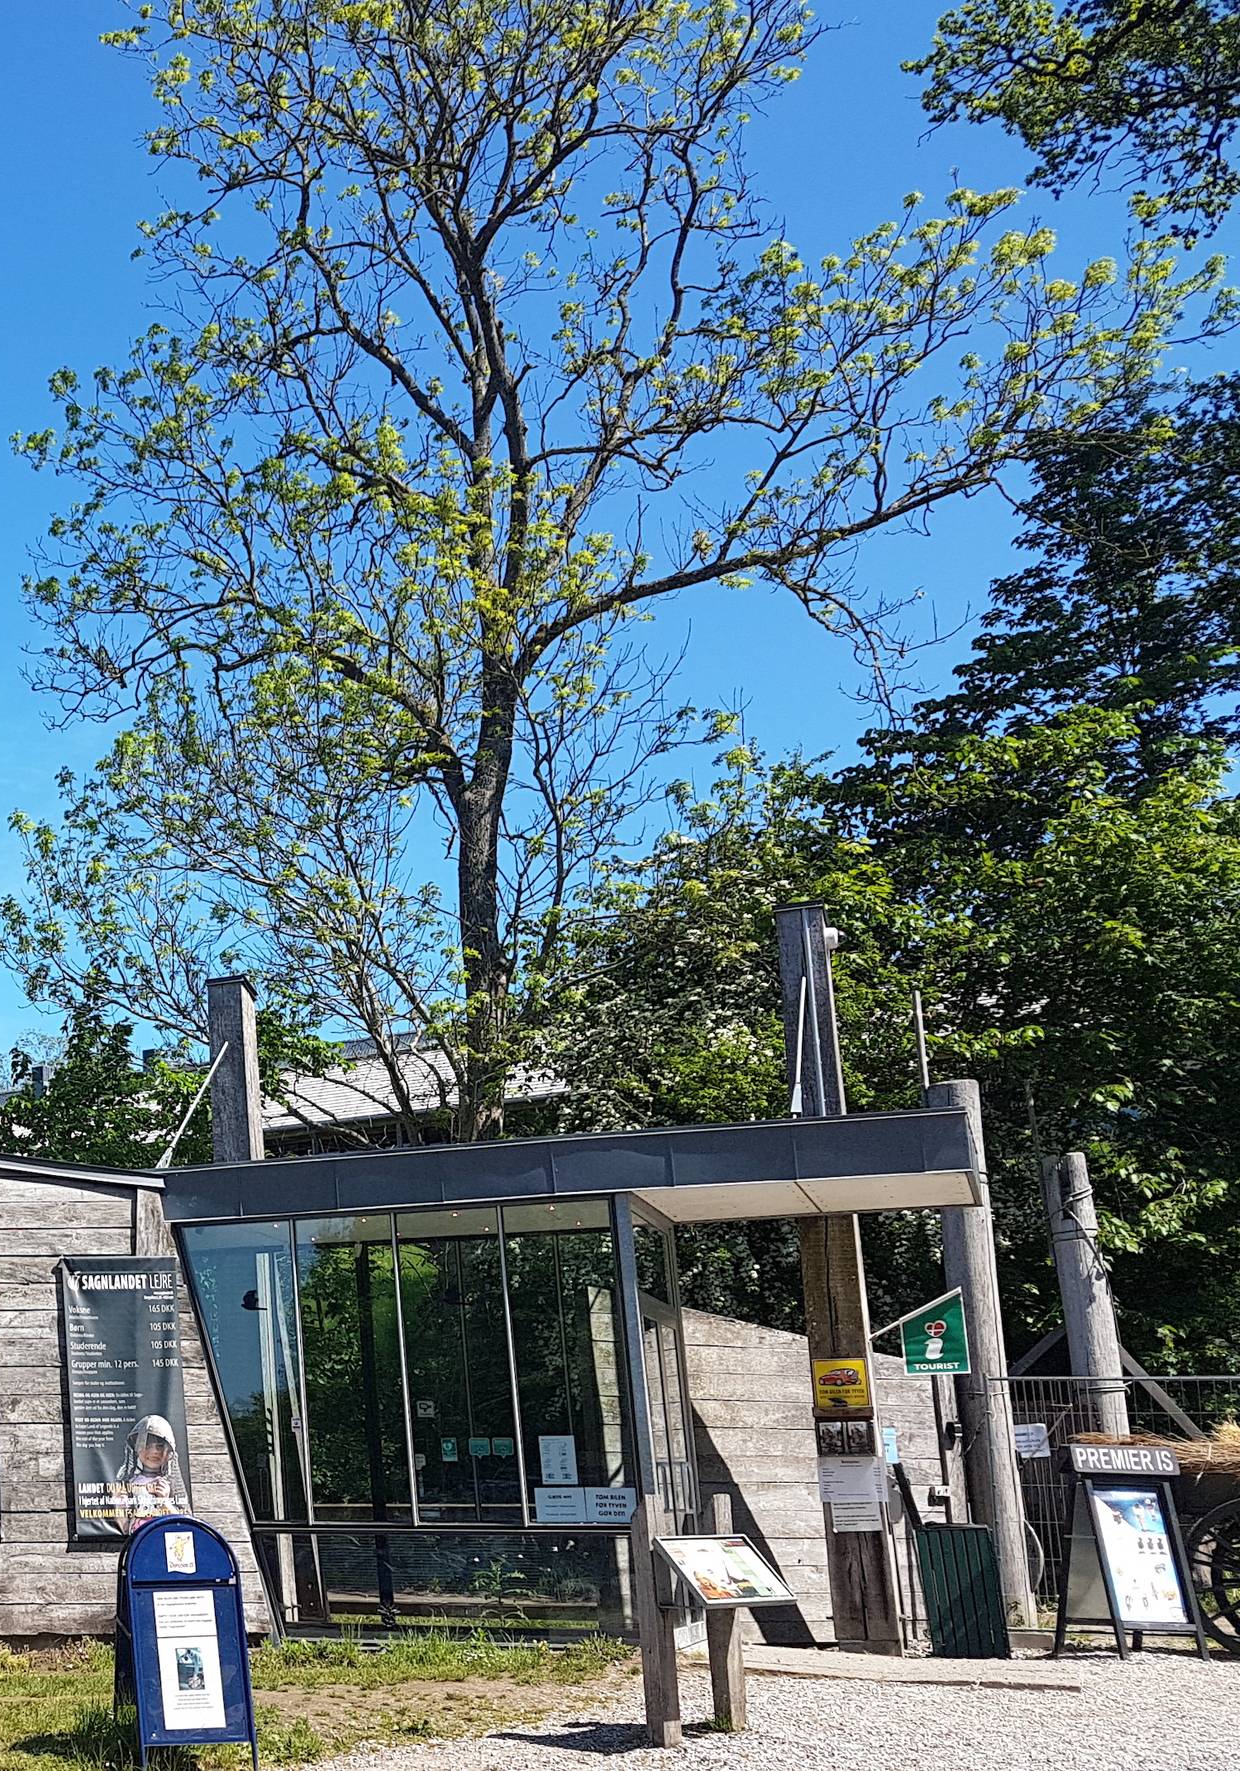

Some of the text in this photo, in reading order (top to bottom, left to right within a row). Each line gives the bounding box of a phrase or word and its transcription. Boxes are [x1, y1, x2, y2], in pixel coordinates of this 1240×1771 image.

[81, 1273, 173, 1290] SAGNLANDET LEJRE
[68, 1303, 175, 1314] Voksne 165 DKK
[69, 1322, 176, 1332] Børn 105 DKK
[70, 1340, 177, 1351] Studerende 105 DKK
[71, 1358, 179, 1370] Grupper min. 12 pers. 145 DKK
[913, 1361, 960, 1370] TOURIST
[1075, 1448, 1174, 1471] PREMIER IS
[78, 1482, 104, 1494] LANDET
[80, 1508, 124, 1519] VELKOMMEN
